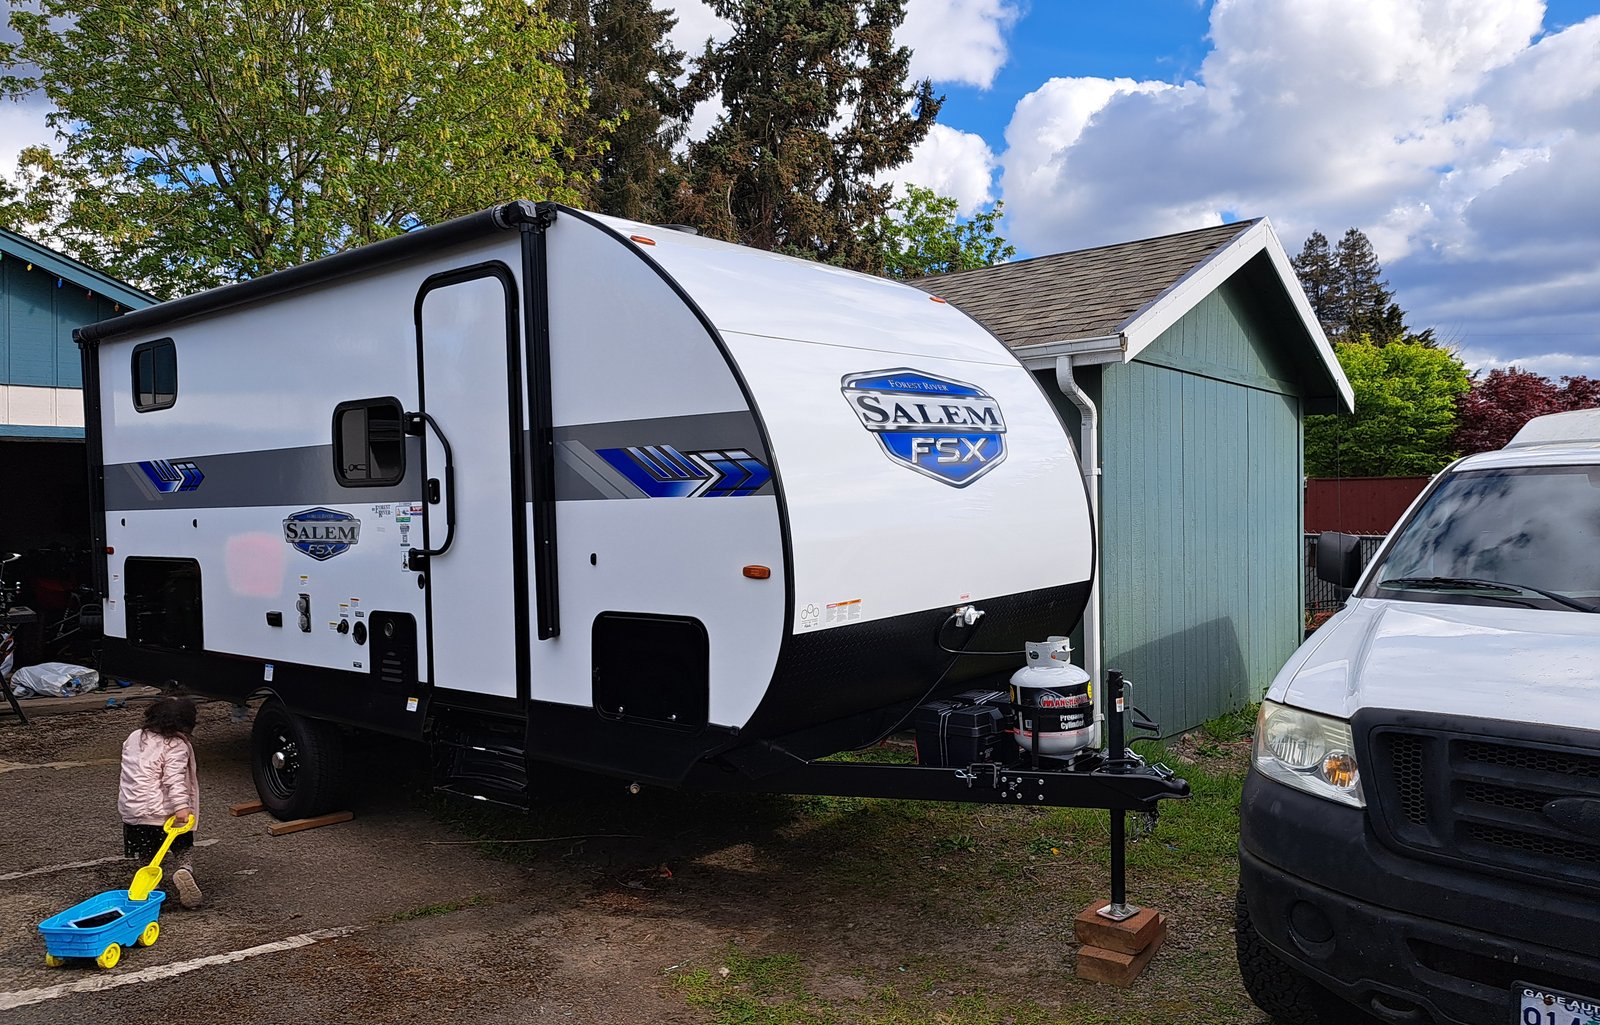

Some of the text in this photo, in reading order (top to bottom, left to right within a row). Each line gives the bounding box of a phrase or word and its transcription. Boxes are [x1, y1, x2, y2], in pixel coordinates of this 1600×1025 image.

[888, 380, 949, 392] FOREST RIVER
[856, 395, 1002, 426] SALEM
[911, 437, 989, 464] FSX
[286, 522, 358, 540] SALEM
[308, 544, 336, 555] FSX
